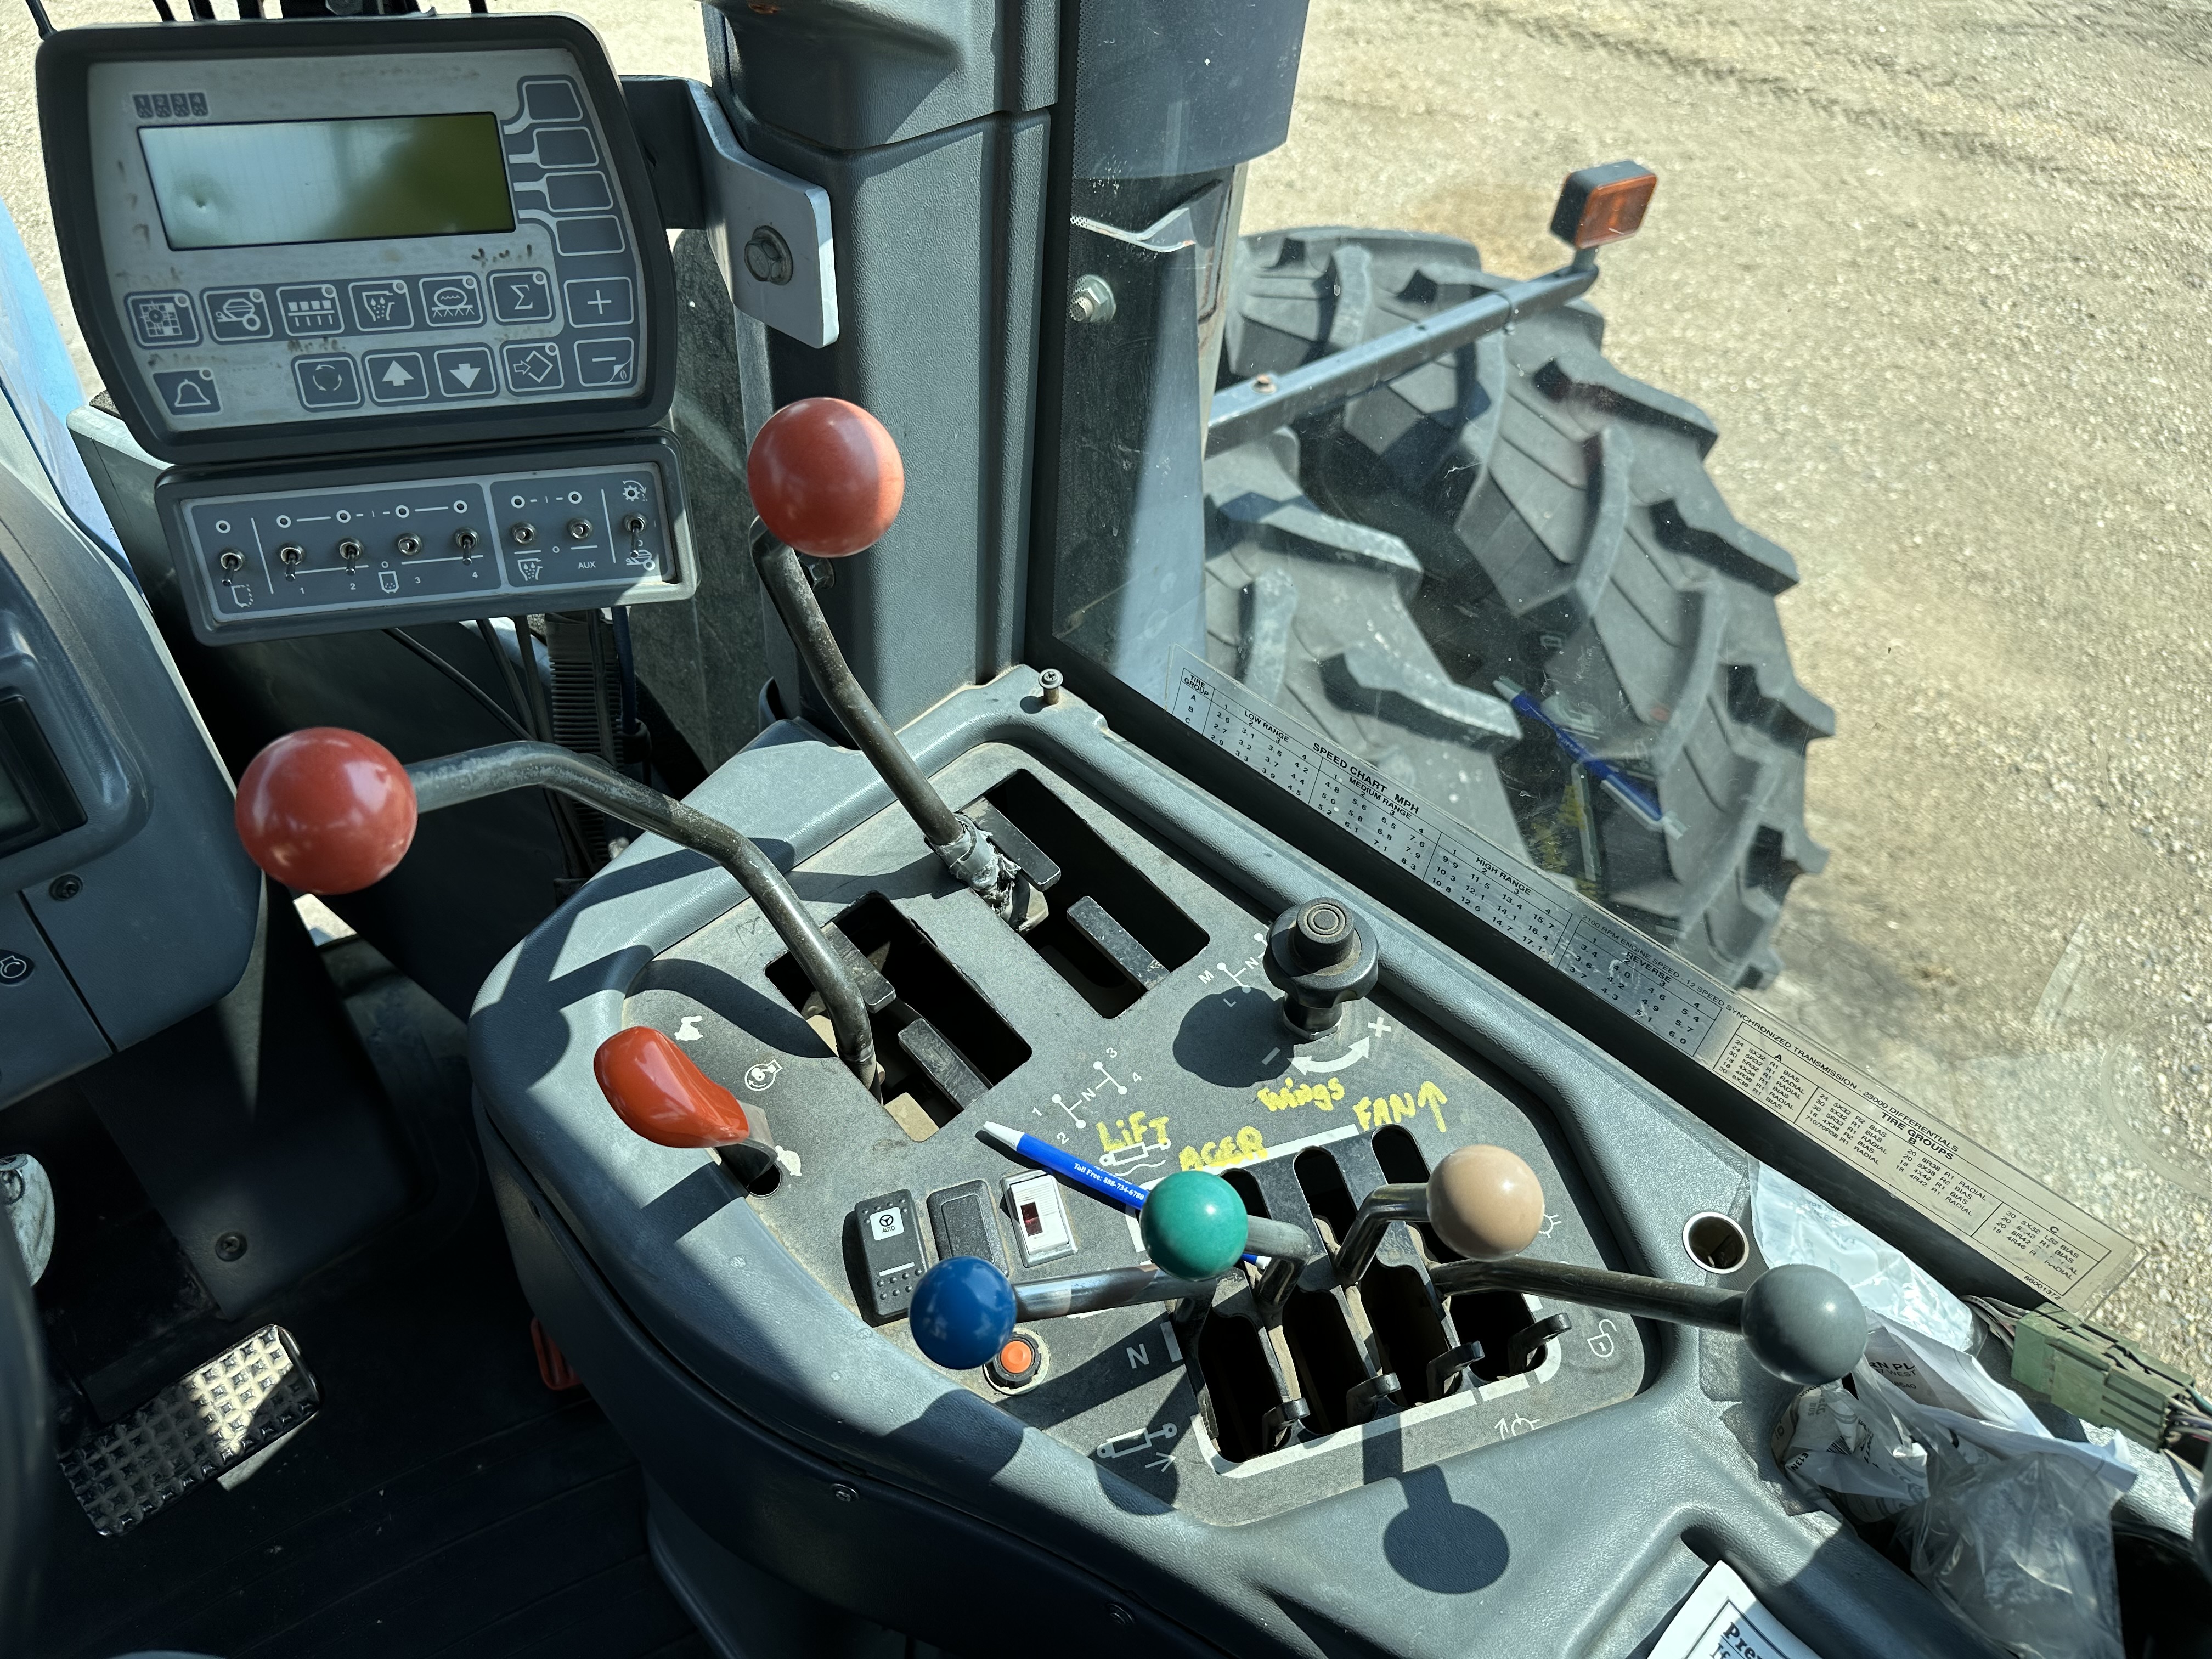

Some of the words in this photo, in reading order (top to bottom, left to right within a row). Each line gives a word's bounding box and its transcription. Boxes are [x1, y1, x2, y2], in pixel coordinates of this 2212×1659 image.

[578, 561, 596, 569] AUX
[1184, 678, 1209, 696] GROUP
[1190, 674, 1206, 689] TIRE
[1244, 710, 1262, 724] LOW
[1262, 722, 1289, 743] RANGE
[1313, 743, 1347, 769] SPEED
[1350, 766, 1387, 793] CHART
[1394, 794, 1419, 814] MPH
[1349, 777, 1381, 801] MEDIUM
[1383, 798, 1412, 820] RANGE
[1476, 857, 1498, 874] HIGH
[1499, 872, 1532, 896] RANGE
[1245, 956, 1259, 970] N
[1626, 951, 1672, 984] REVERSE
[1198, 970, 1214, 984] M
[1582, 915, 1600, 928] 2100
[1601, 926, 1620, 940] RPM
[1620, 938, 1651, 960] ENGINE
[1652, 958, 1680, 978] SPEED
[1686, 980, 1696, 988] 12
[1696, 986, 1725, 1006] SPEED
[1725, 1005, 1792, 1048] SYNCHRONIZED
[1793, 1046, 1858, 1090] TRANSMISSION
[1863, 1091, 1888, 1109] 23000
[1889, 1107, 1959, 1152] DIFFERENTIALS
[1105, 1047, 1118, 1058] 3
[1133, 1071, 1143, 1083] 4
[1779, 1075, 1804, 1094] RADIAL
[1782, 1070, 1801, 1083] BIAS
[1081, 1088, 1096, 1102] N
[1772, 1086, 1790, 1099] BIAS
[1775, 1081, 1801, 1100] RADIAL
[1765, 1097, 1782, 1109] BIAS
[1769, 1091, 1794, 1111] RADIAL
[1032, 1107, 1042, 1117] 1
[1352, 1092, 1418, 1131] FAN
[1057, 1132, 1069, 1145] 2
[1865, 1130, 1883, 1143] BIAS
[1869, 1124, 1887, 1138] BIAS
[1882, 1111, 1906, 1131] TIRE
[1907, 1129, 1954, 1160] GROUPS
[1805, 1114, 1839, 1138] 710/70R38
[1853, 1146, 1879, 1165] RADIAL
[1857, 1140, 1875, 1154] BIAS
[1861, 1135, 1887, 1155] RADIAL
[1908, 1137, 1917, 1145] B
[1074, 1162, 1086, 1175] Toll
[1086, 1169, 1103, 1181] Free:
[1103, 1176, 1144, 1201] 888-734-6780
[1949, 1191, 1968, 1205] BIAS
[1954, 1186, 1973, 1199] BIAS
[1959, 1181, 1985, 1201] RADIAL
[1945, 1196, 1972, 1216] RADIAL
[882, 1226, 895, 1234] AUTO
[2044, 1234, 2059, 1245] LS2
[2060, 1244, 2079, 1259] BIAS
[2054, 1249, 2074, 1263] BIAS
[2024, 1275, 2061, 1301] 86001372
[1126, 1343, 1149, 1369] N
